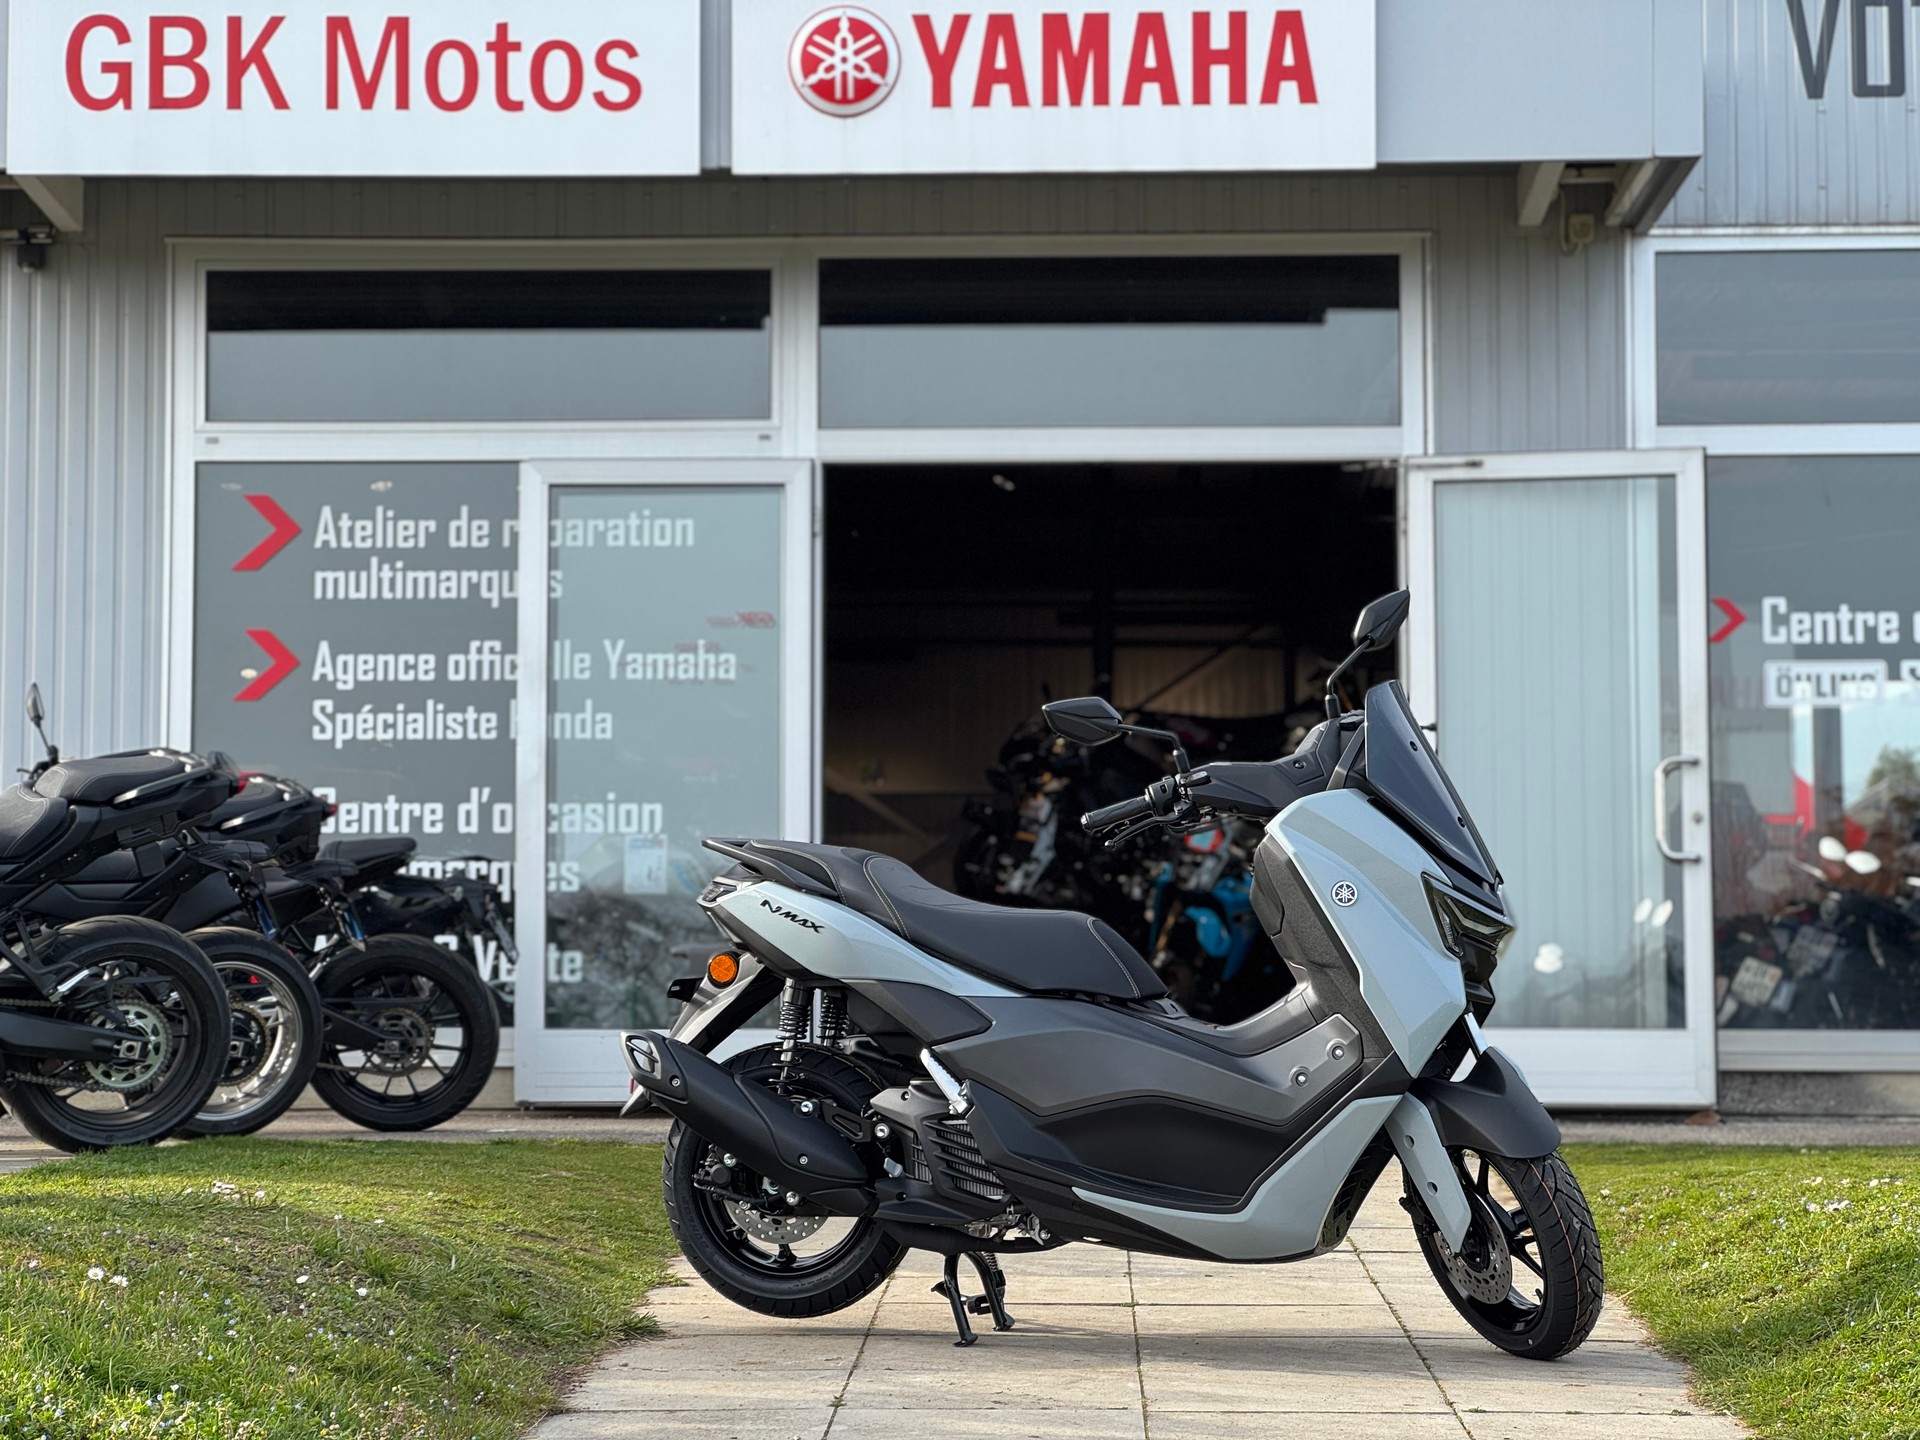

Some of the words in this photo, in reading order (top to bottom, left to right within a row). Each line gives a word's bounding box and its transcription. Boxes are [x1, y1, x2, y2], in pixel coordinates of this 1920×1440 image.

[64, 13, 291, 112] GBK
[324, 15, 643, 113] Motos
[912, 10, 1318, 108] YAMAHA
[1785, 0, 1920, 100] VO
[313, 504, 437, 549] Atelier
[448, 504, 490, 548] de
[313, 556, 563, 609] multimarqus
[1761, 595, 1901, 645] Centre
[311, 639, 437, 691] Agence
[447, 639, 592, 681] officlle
[602, 638, 737, 681] Yamaha
[311, 698, 499, 750] Spécialiste
[759, 898, 826, 935] NMAX
